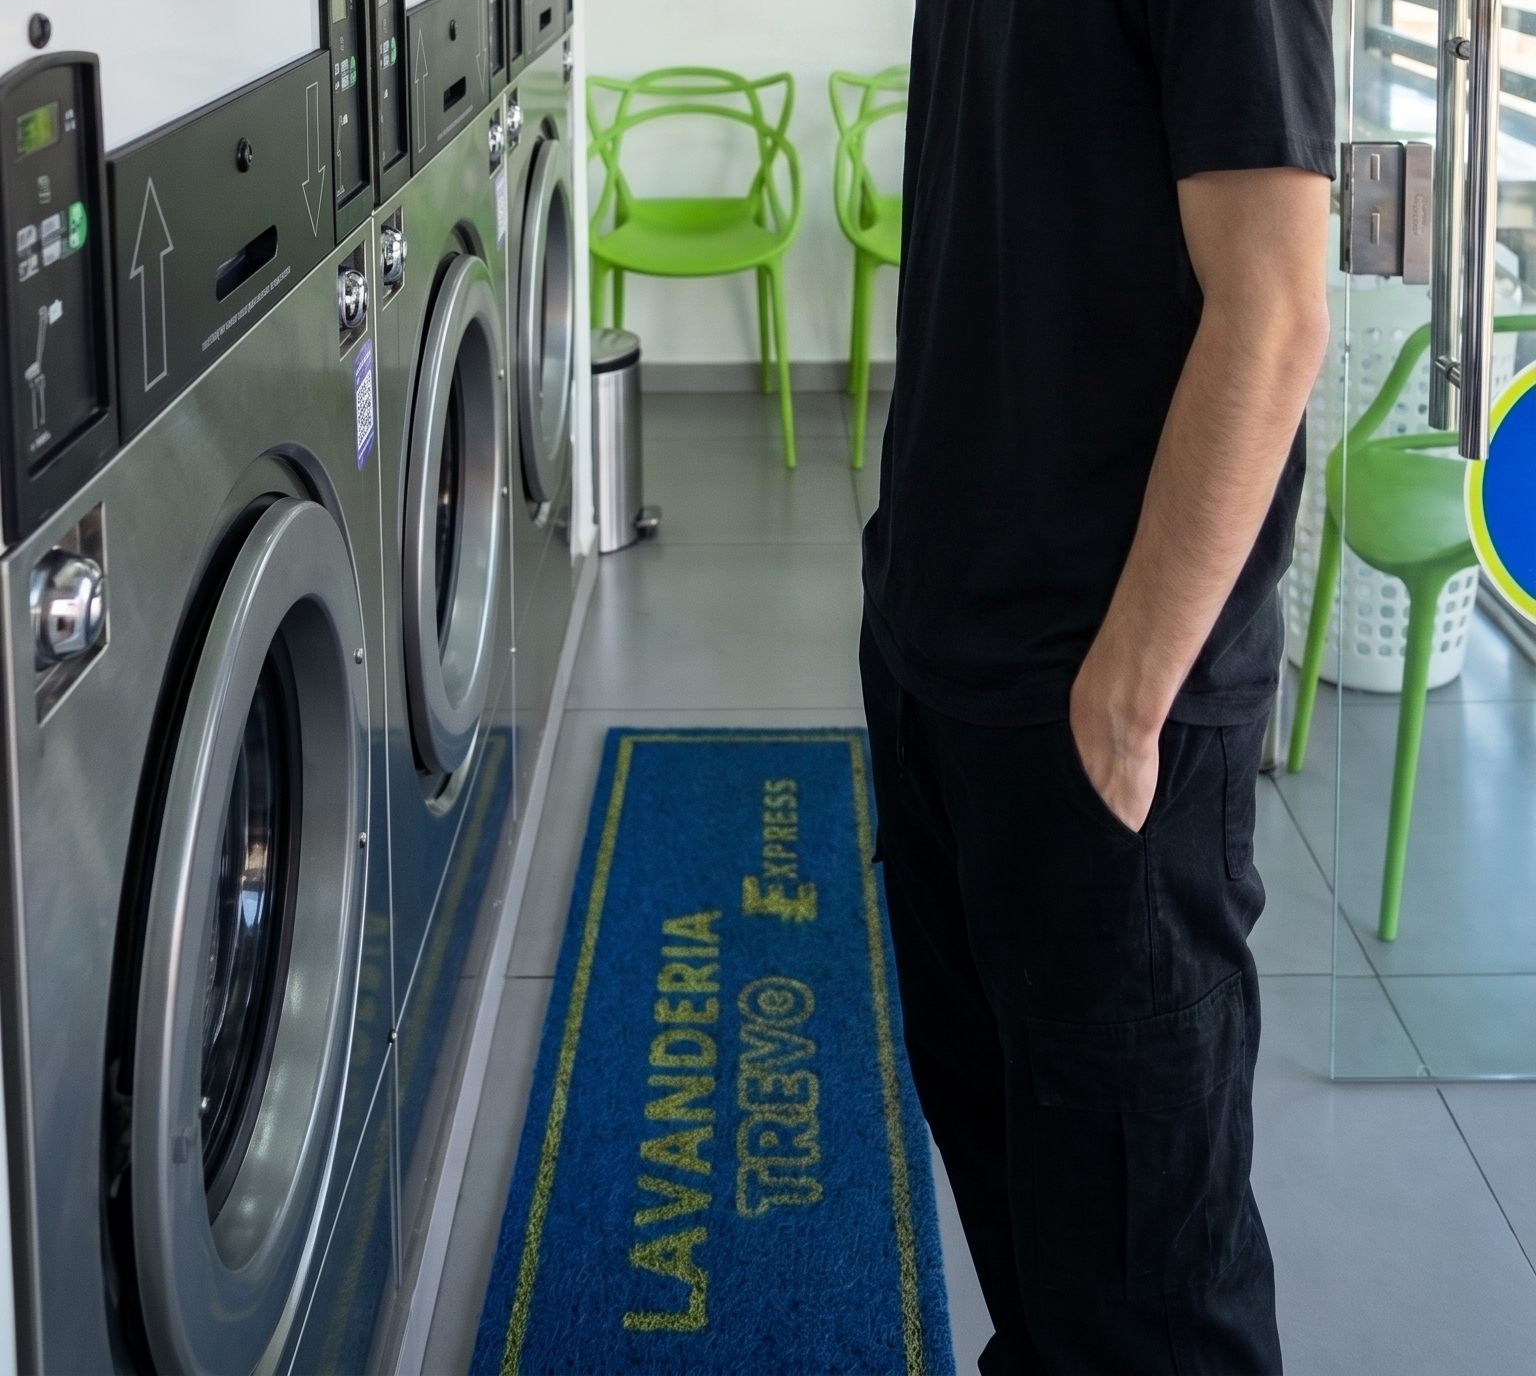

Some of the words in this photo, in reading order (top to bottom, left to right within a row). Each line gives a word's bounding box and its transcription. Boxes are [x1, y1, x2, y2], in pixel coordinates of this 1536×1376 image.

[741, 776, 818, 923] EXPRESS
[622, 908, 723, 1333] LAVANDERIA
[734, 974, 823, 1218] TREVO
